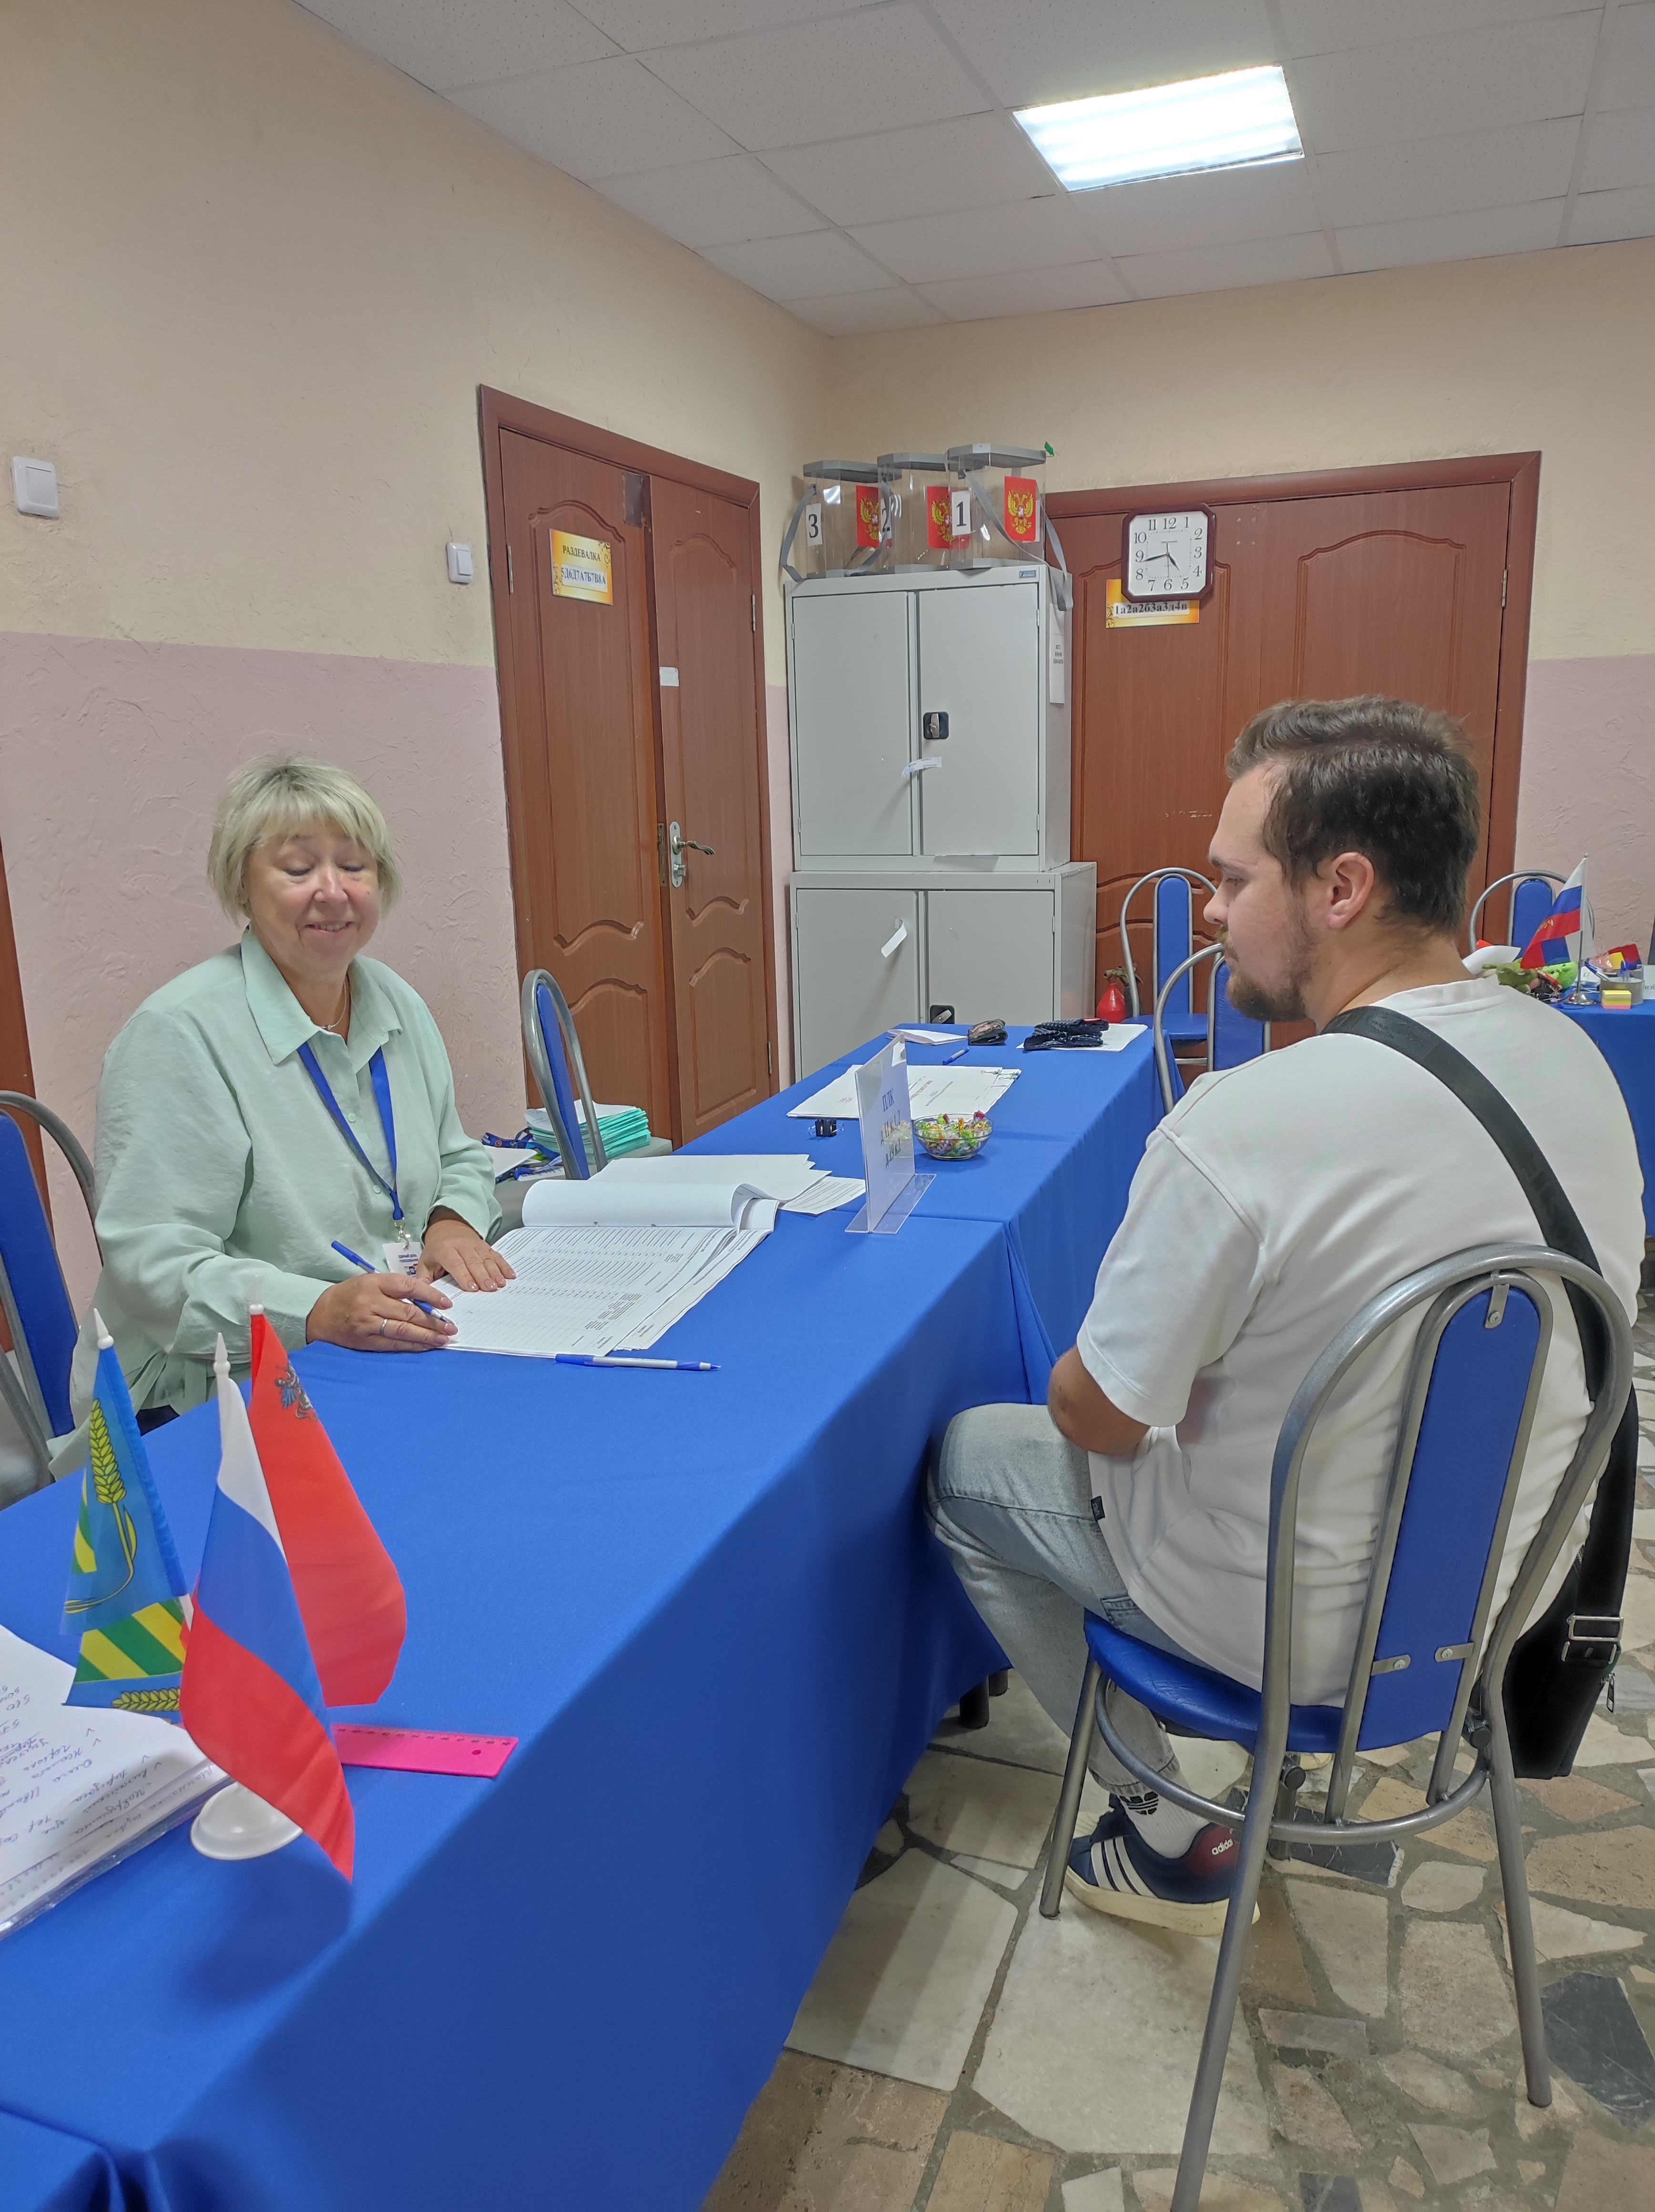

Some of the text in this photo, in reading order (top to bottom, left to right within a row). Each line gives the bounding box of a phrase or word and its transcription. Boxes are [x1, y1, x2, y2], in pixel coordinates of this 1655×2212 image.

[956, 501, 967, 527] 1
[808, 513, 818, 538] 3
[1148, 519, 1157, 531] 11
[1163, 517, 1177, 529] 12
[1184, 516, 1190, 528] 1
[1134, 532, 1147, 544] 10
[1194, 528, 1203, 540] 2
[562, 545, 601, 562] РАЗДЕВАЛКА
[1135, 550, 1144, 563] 9
[1194, 546, 1202, 558] 3
[1135, 568, 1144, 580] 8
[1193, 565, 1202, 577] 4
[1148, 579, 1156, 592] 7
[1164, 579, 1173, 591] 6
[1181, 577, 1189, 590] 5
[882, 1088, 895, 1112] ПЛК
